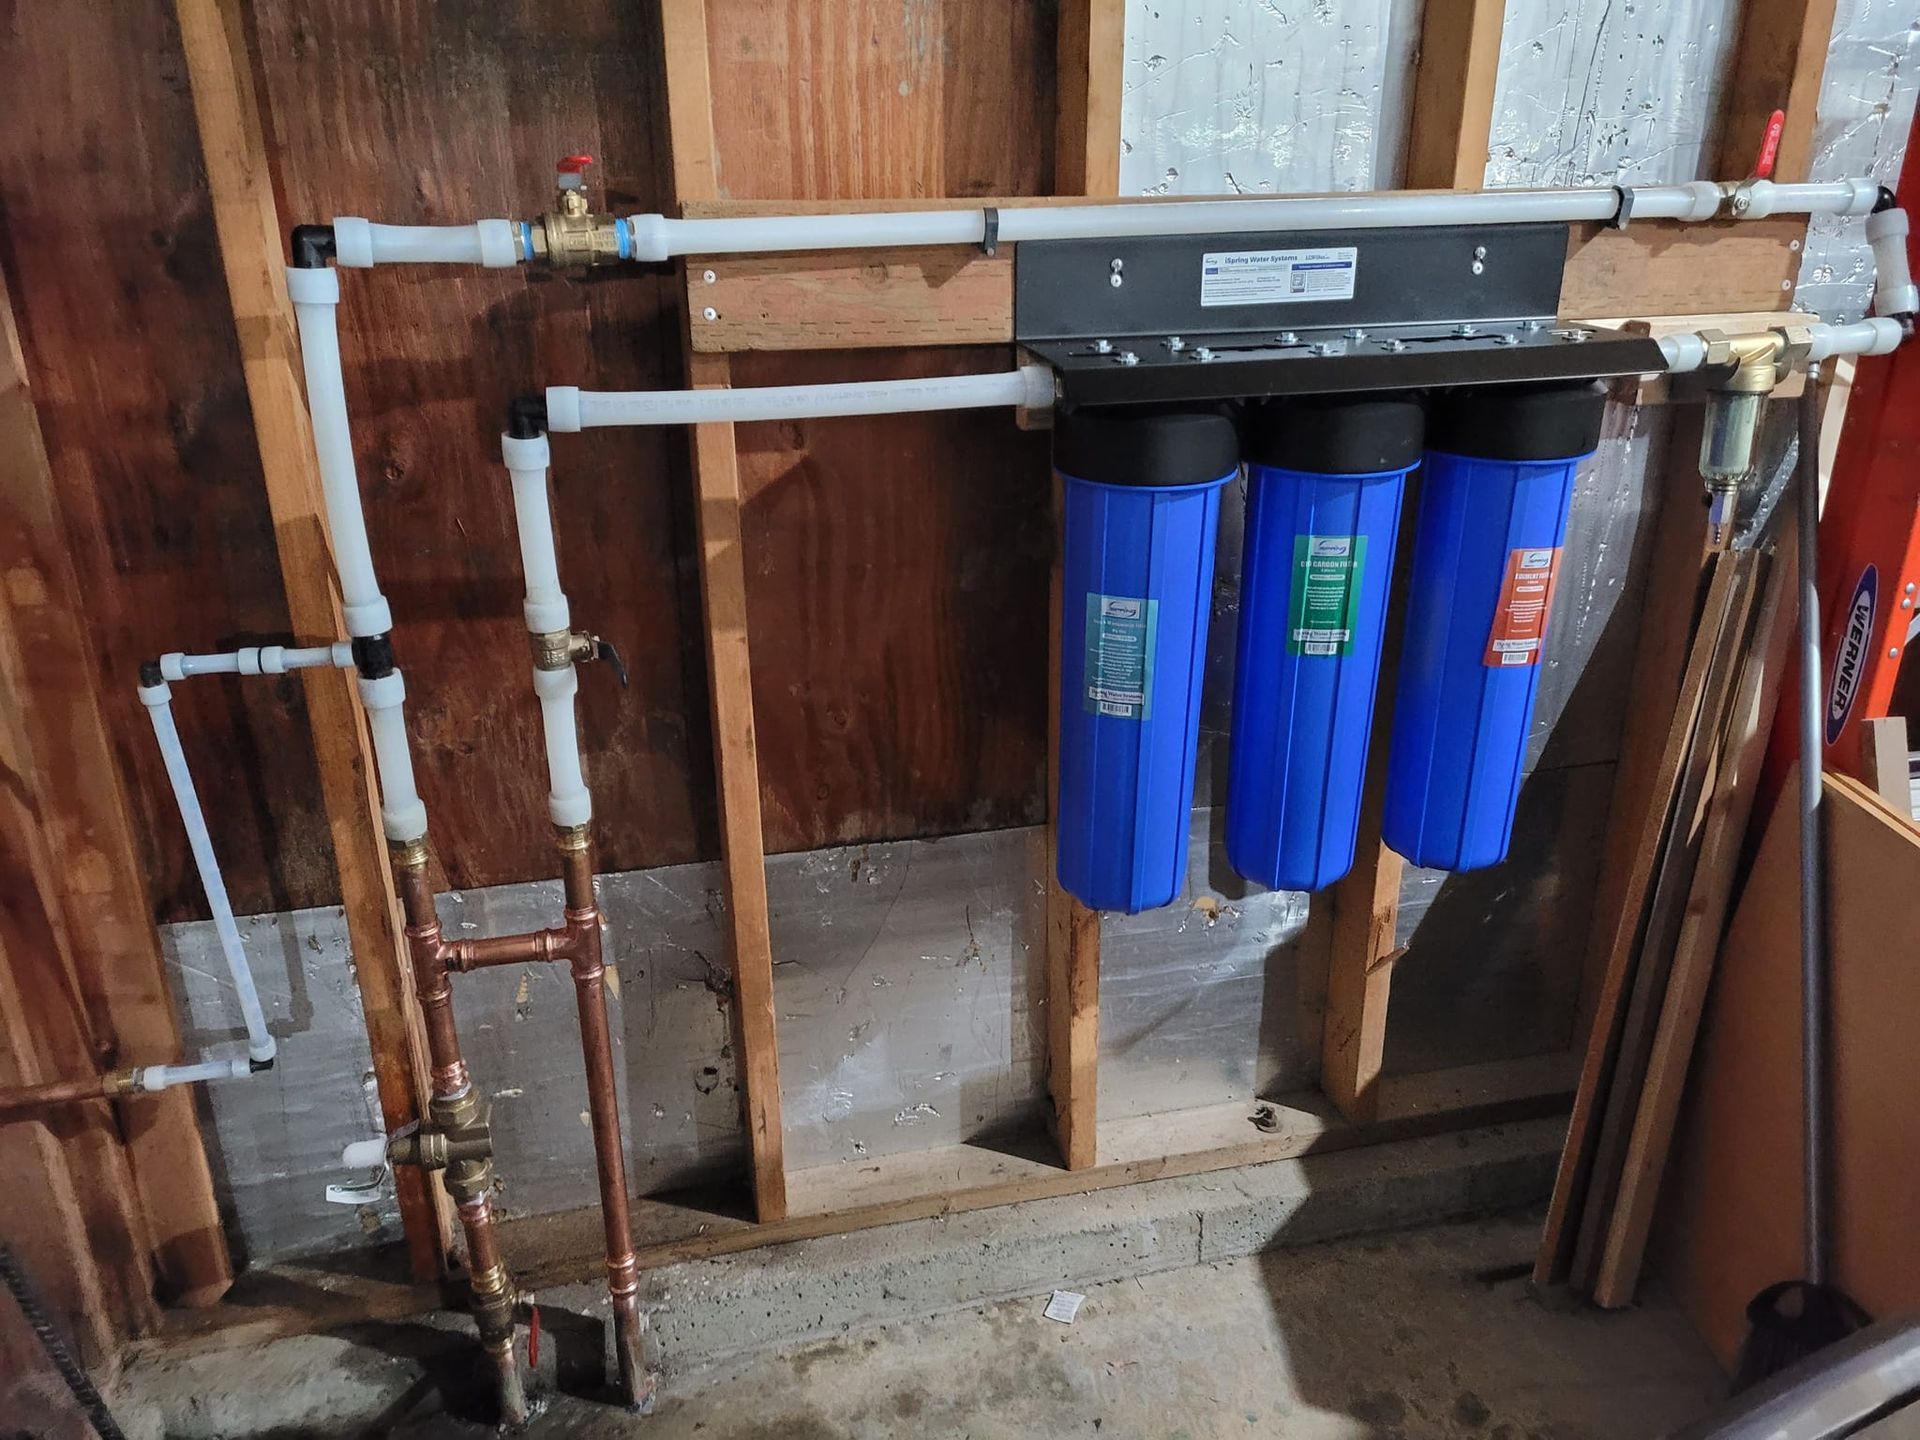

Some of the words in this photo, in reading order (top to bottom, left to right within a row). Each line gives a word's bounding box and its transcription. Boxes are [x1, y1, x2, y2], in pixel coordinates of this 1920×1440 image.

[1224, 256, 1249, 265] iSpring
[1249, 255, 1270, 264] Water
[1270, 254, 1298, 263] Systems
[1833, 604, 1870, 711] WERNER
